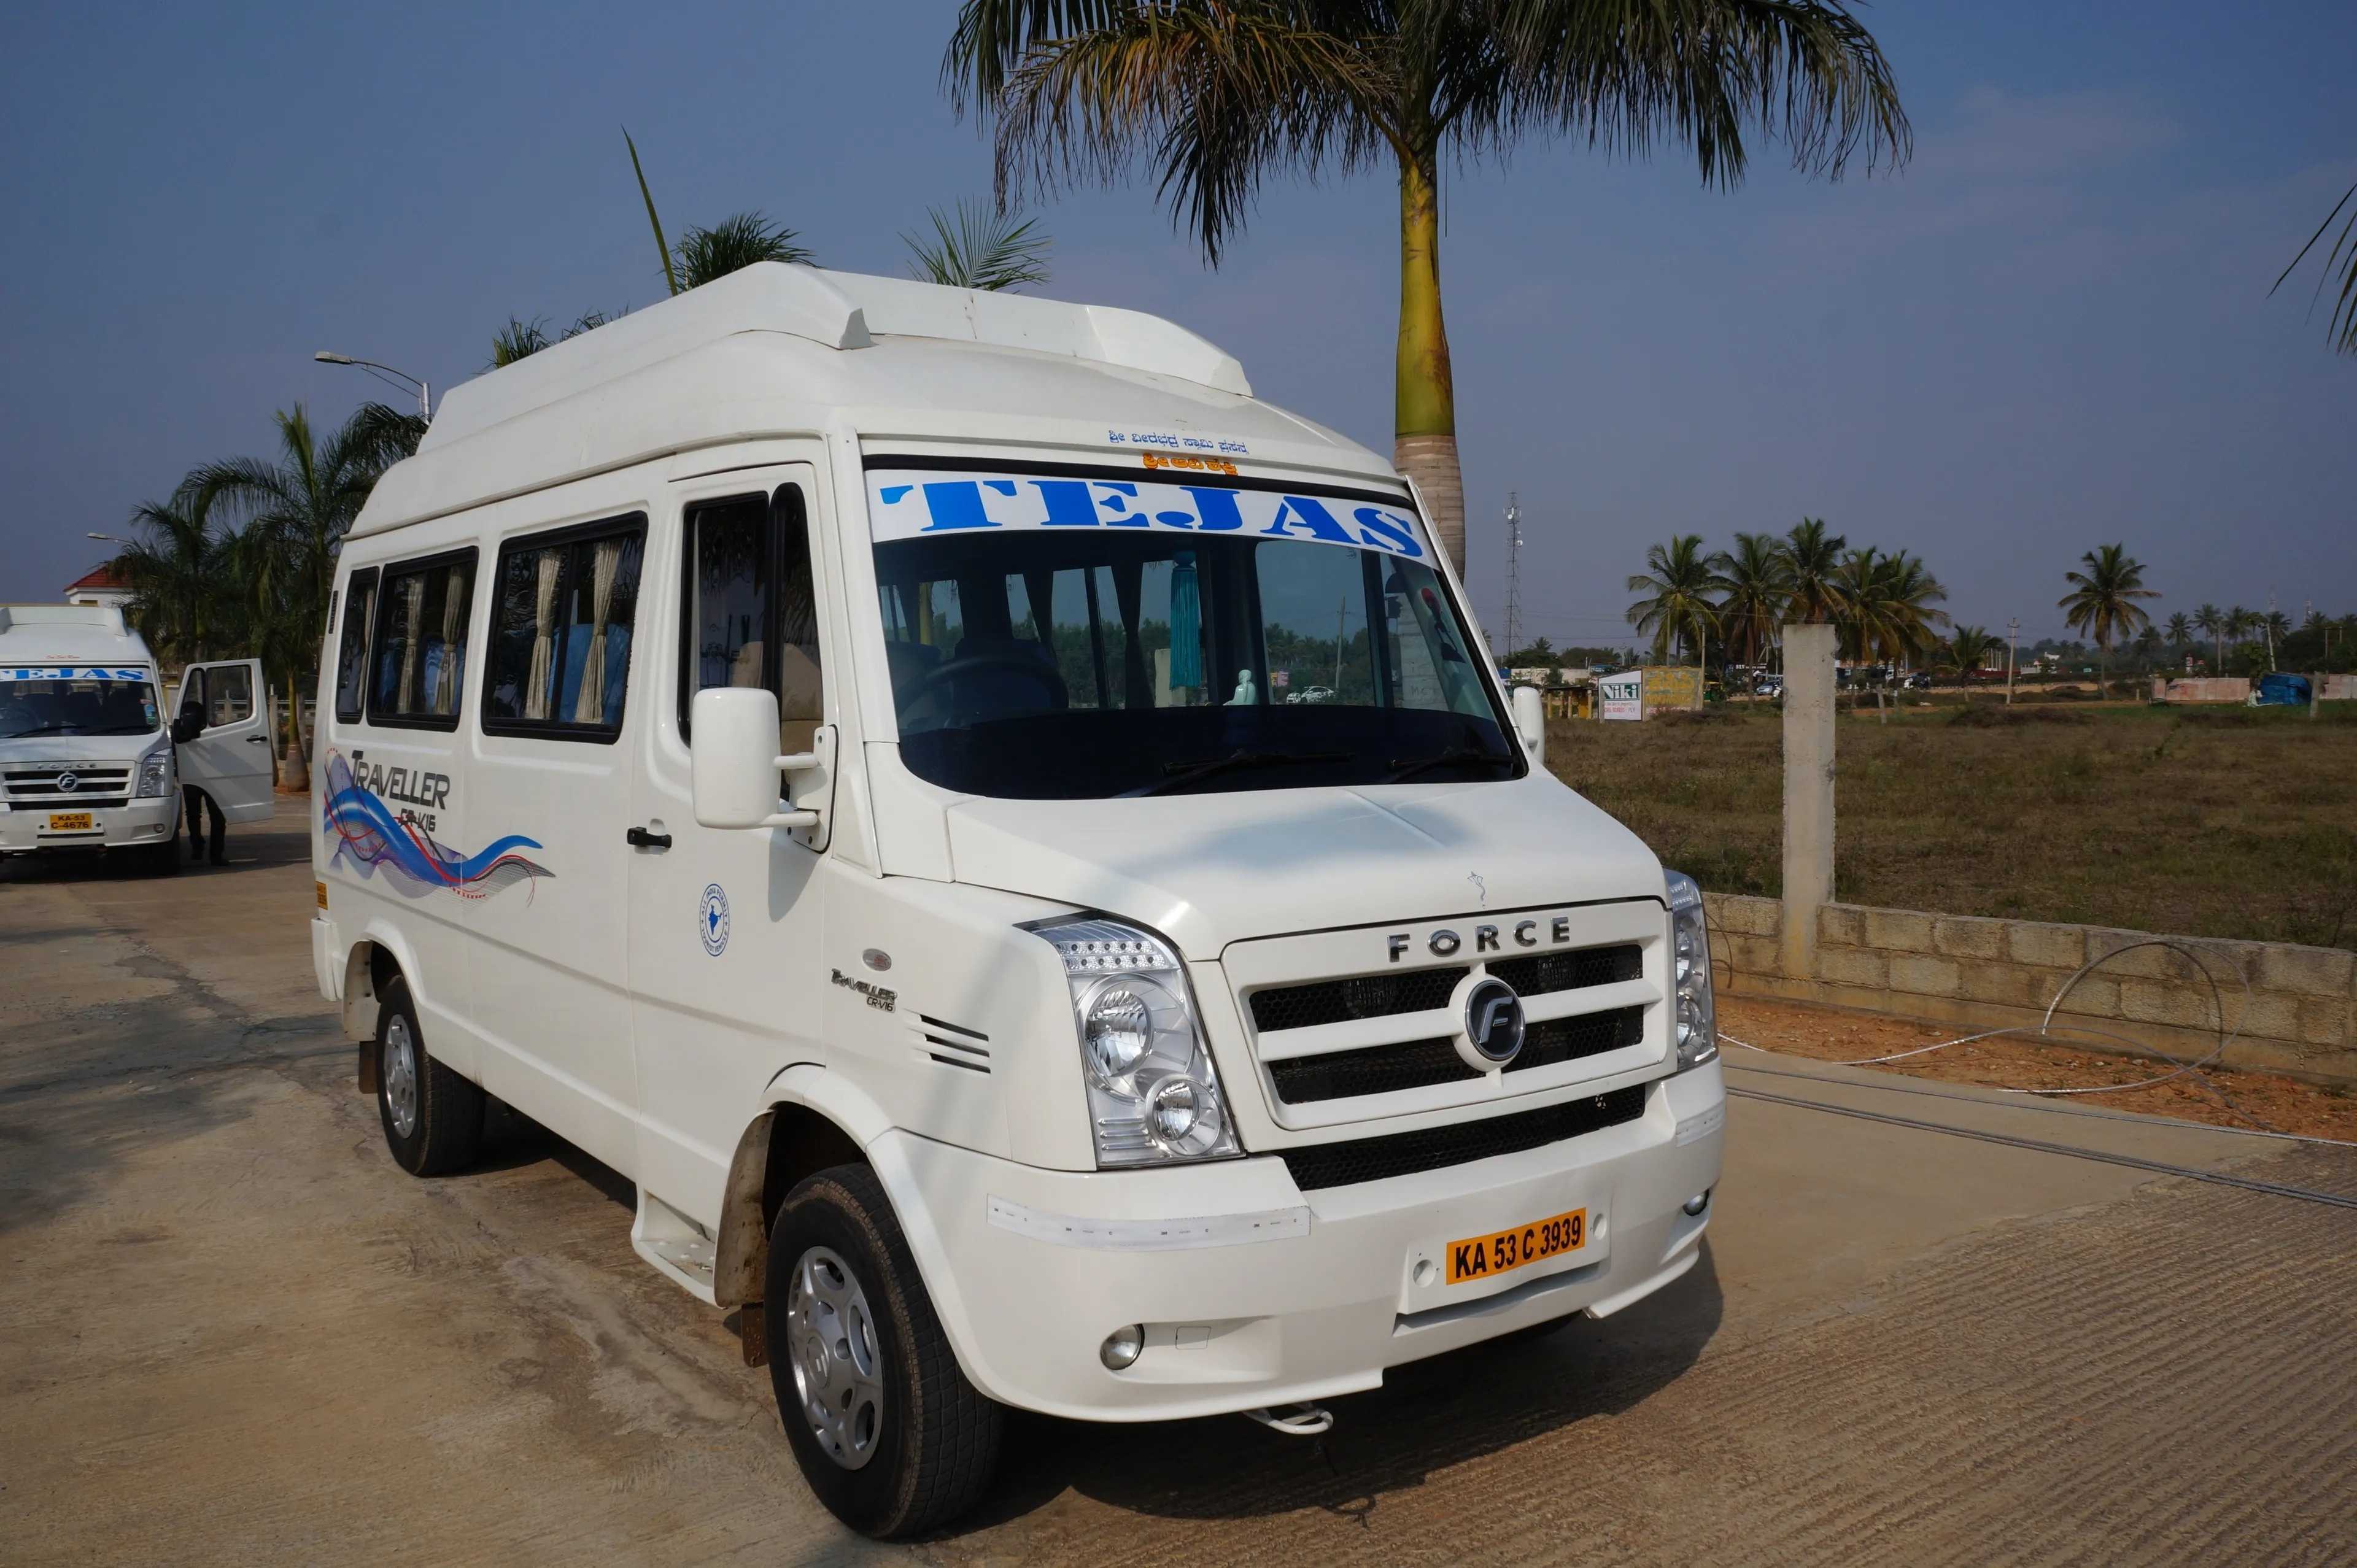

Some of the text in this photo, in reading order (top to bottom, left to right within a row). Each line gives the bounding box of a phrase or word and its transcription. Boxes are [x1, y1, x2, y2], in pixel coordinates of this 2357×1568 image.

[1109, 430, 1125, 443] ಶ್ರೀ
[879, 480, 1423, 558] TEJAS
[352, 750, 451, 809] TRAVELLER
[1386, 916, 1570, 963] FORCE
[831, 968, 898, 1003] TRAVELLER
[1455, 1215, 1581, 1278] KA 53 C 3939
